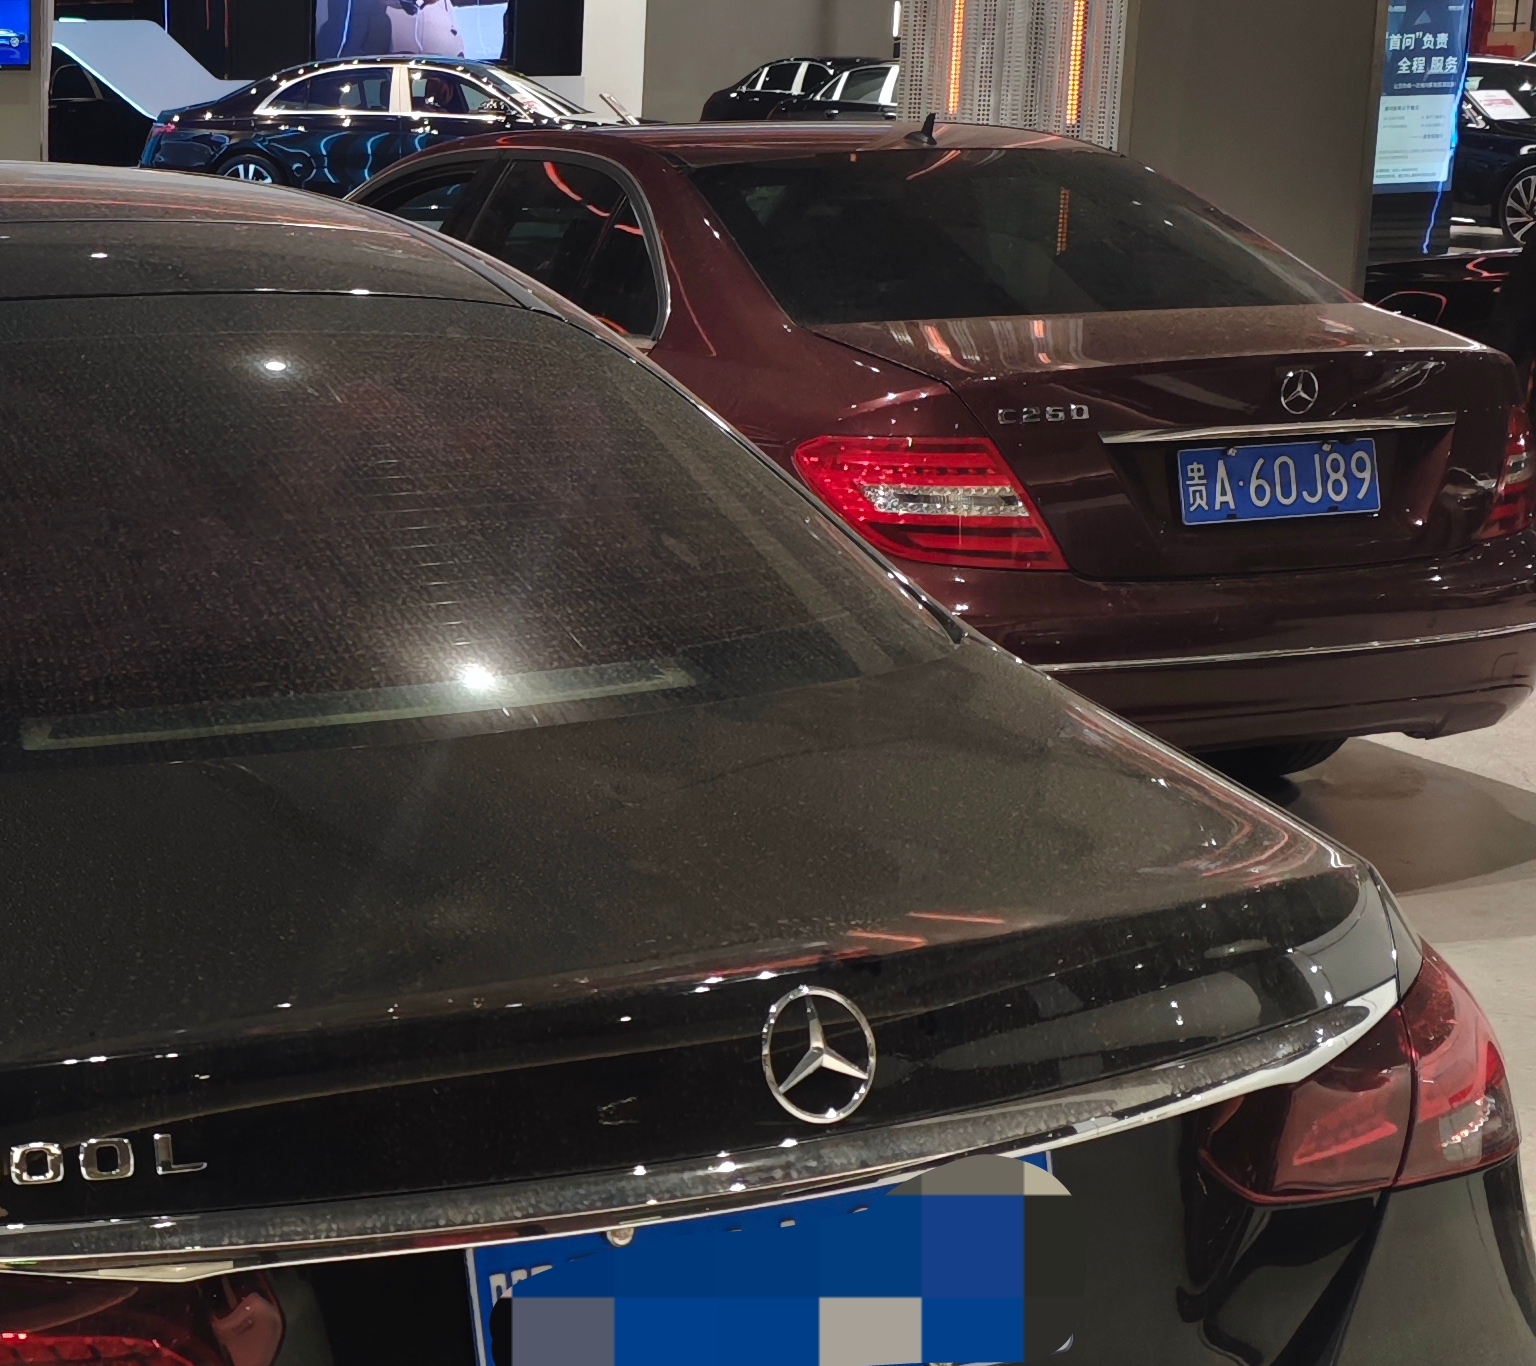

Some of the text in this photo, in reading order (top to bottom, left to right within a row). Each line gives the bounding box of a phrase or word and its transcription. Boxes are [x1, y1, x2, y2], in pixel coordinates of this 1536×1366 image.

[1397, 56, 1458, 74] 全程 服务
[1185, 450, 1372, 511] 贵A·60J89
